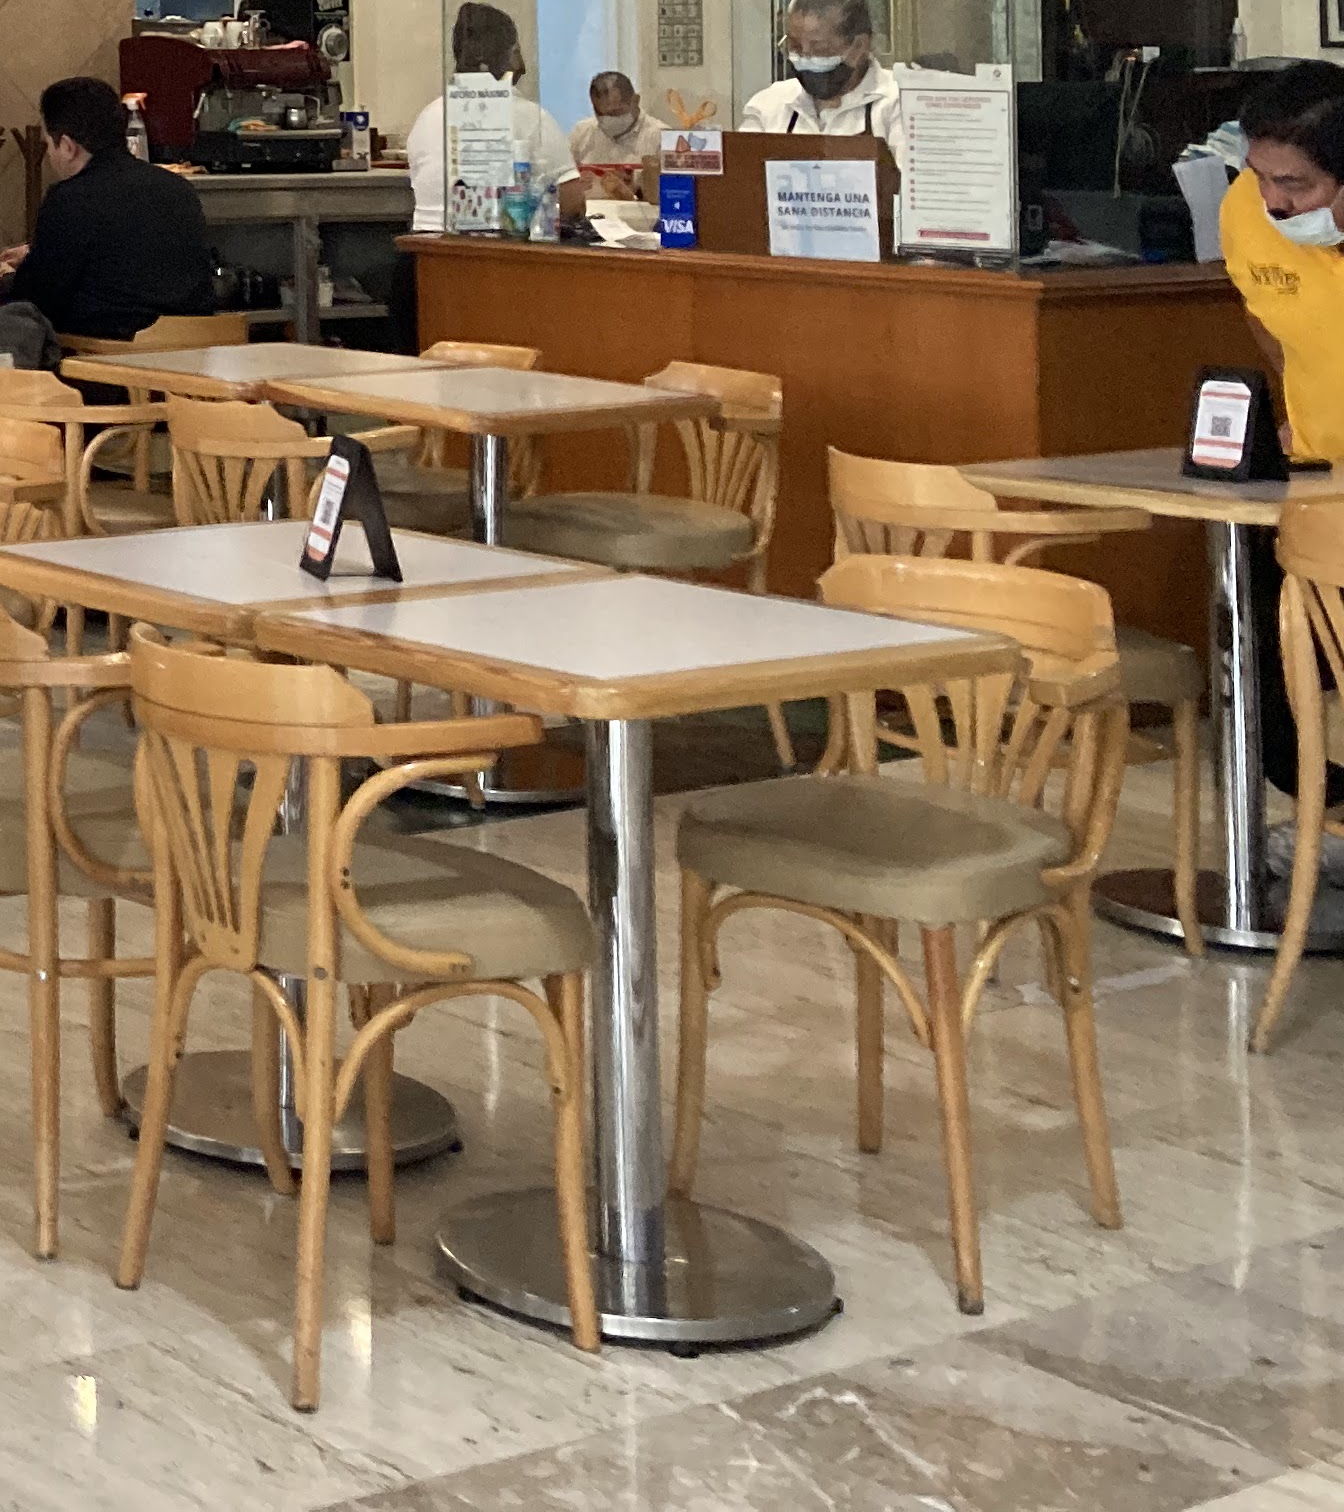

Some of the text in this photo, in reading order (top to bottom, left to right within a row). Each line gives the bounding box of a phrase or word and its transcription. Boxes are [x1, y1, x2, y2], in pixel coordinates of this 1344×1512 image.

[777, 192, 870, 203] MANTENGA UNA
[777, 206, 872, 219] SANA DISTANCIA
[662, 219, 694, 234] VISA
